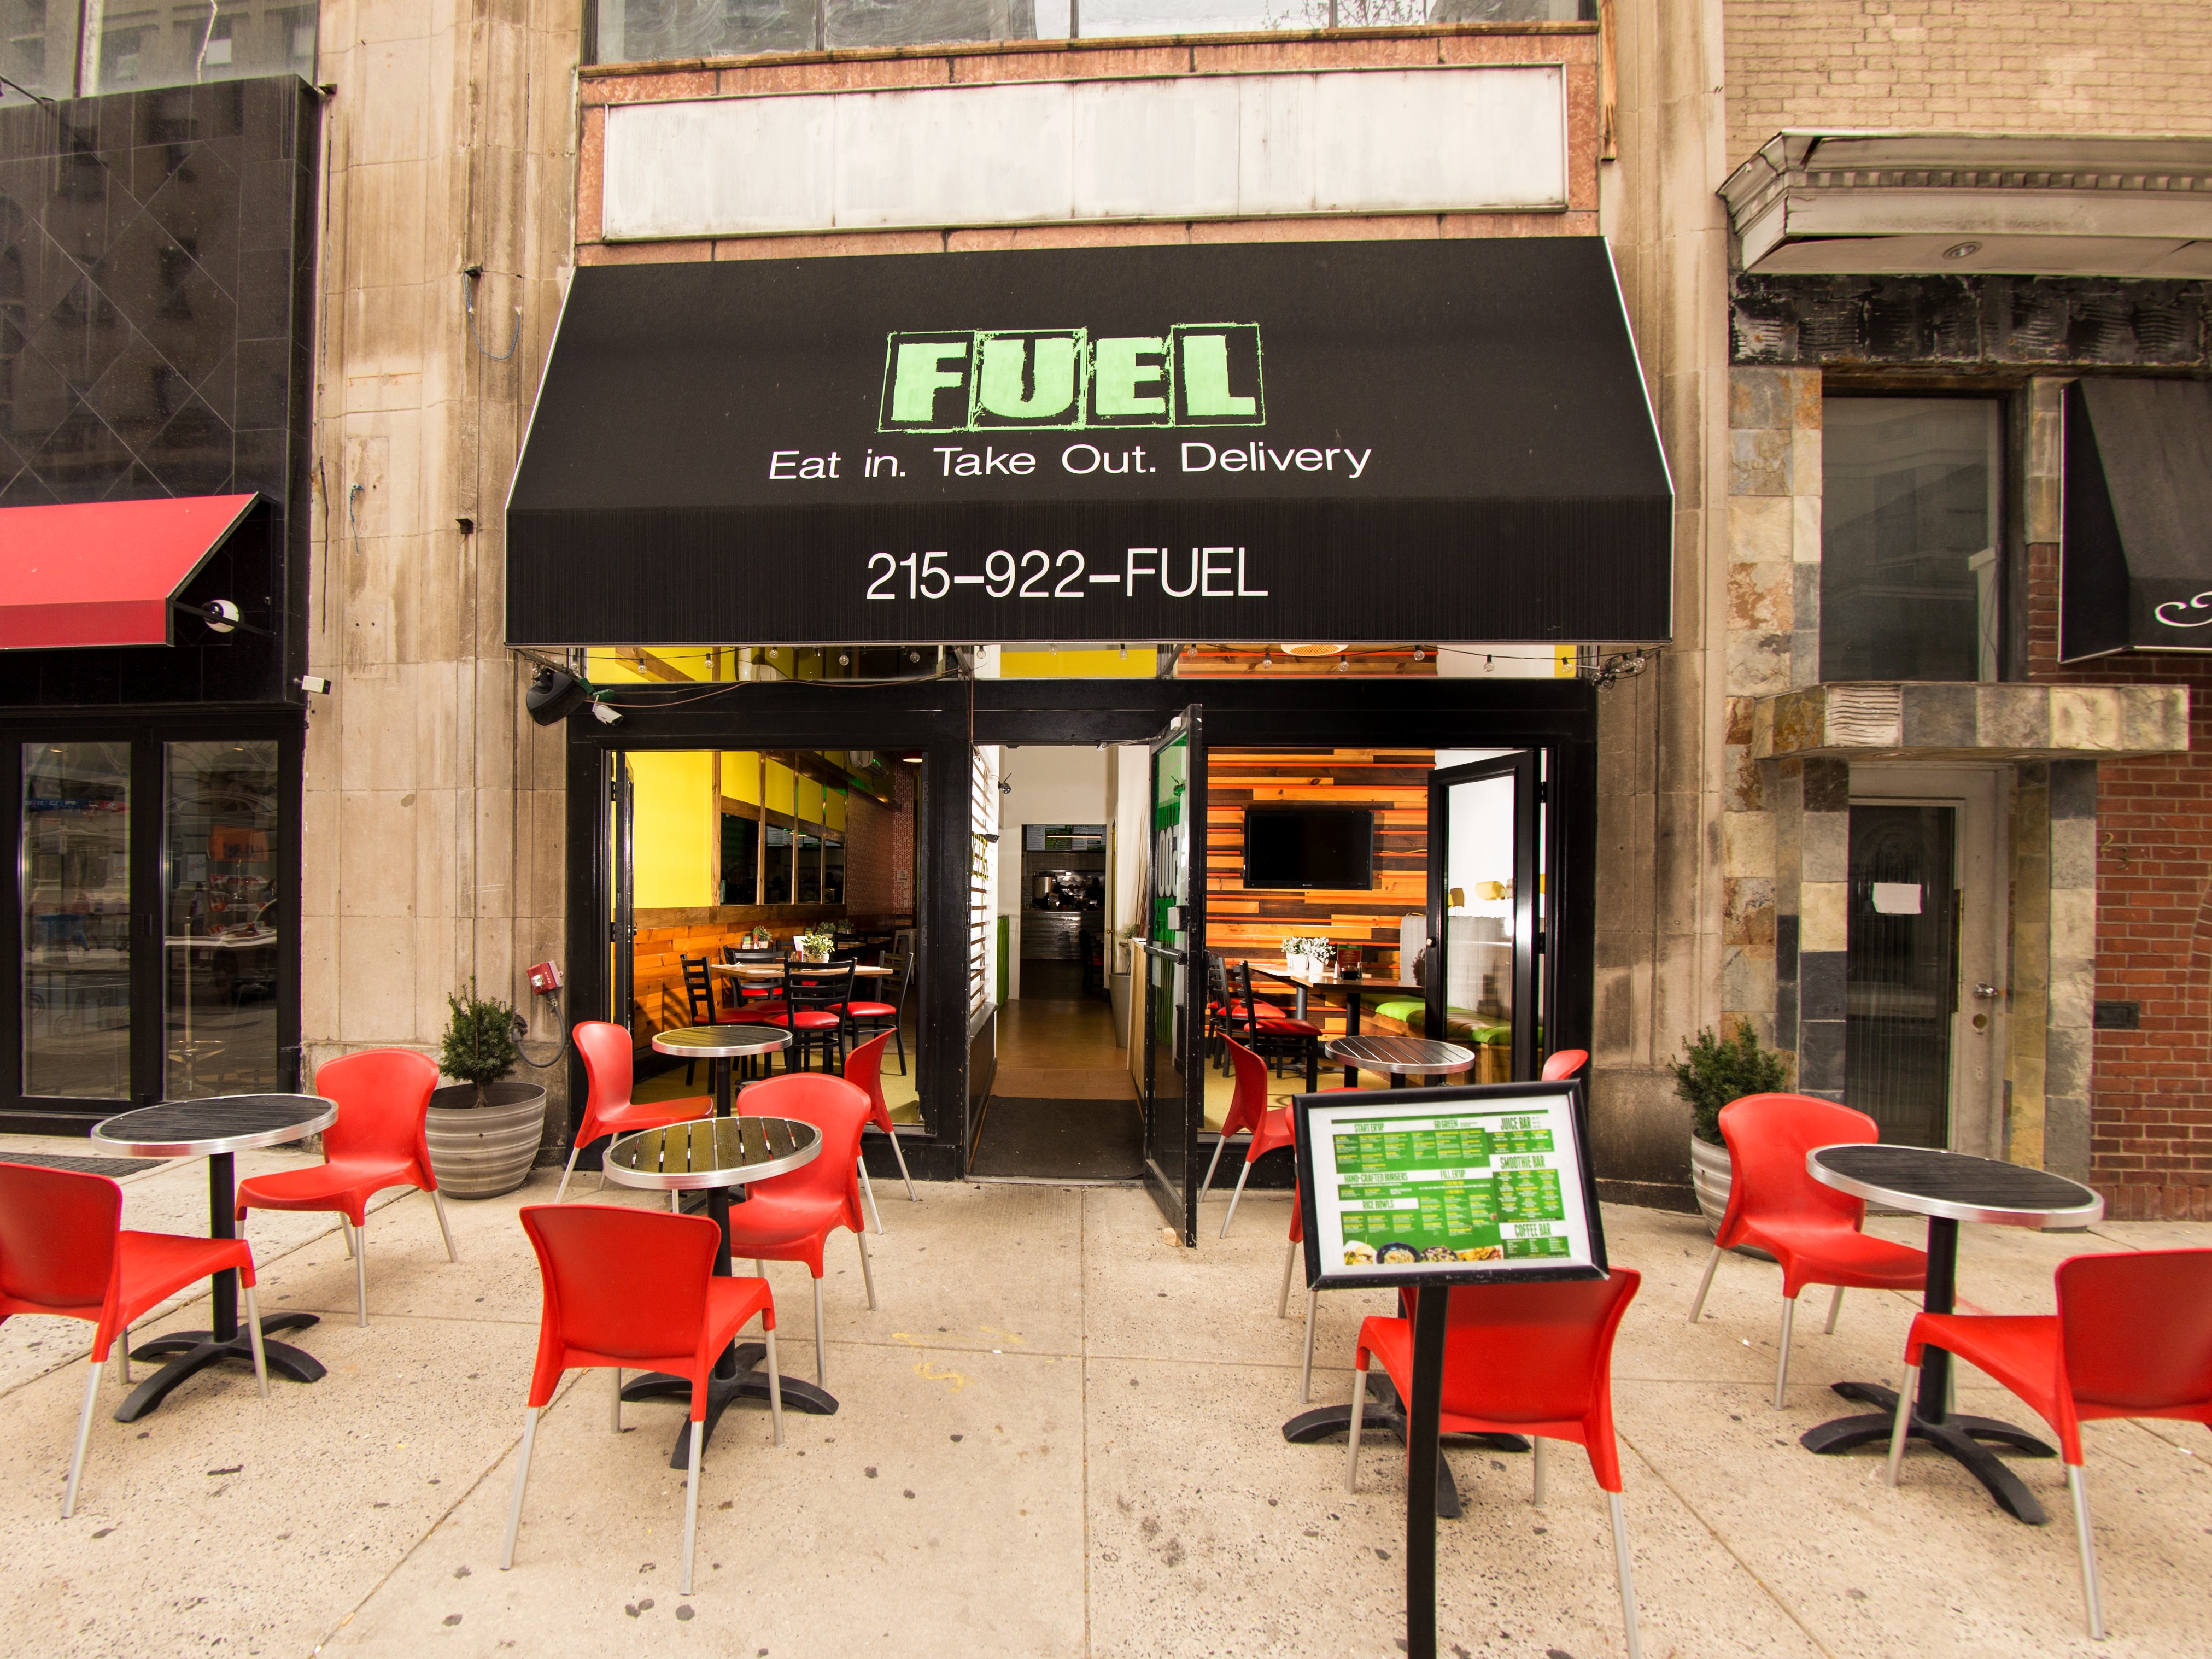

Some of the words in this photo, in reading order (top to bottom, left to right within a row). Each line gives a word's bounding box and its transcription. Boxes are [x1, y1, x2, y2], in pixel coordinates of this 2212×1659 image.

[891, 335, 1257, 421] FUEL
[769, 451, 840, 479] Eat
[864, 449, 906, 477] in.
[933, 447, 1036, 476] Take
[1062, 444, 1157, 474] Out.
[1181, 442, 1372, 478] Delivery
[867, 548, 1268, 599] 215-922-FUEL
[1435, 1121, 1441, 1129] GO
[1442, 1119, 1459, 1128] GREEN
[1500, 1117, 1518, 1130] JUICE
[1519, 1117, 1531, 1129] BAR
[1500, 1156, 1531, 1169] SMOOTHIE
[1532, 1155, 1545, 1168] BAR
[1385, 1173, 1408, 1181] BURGERS
[1363, 1201, 1374, 1209] RICE
[1375, 1200, 1394, 1209] BOWLS
[1514, 1224, 1538, 1238] COFFEE
[1538, 1223, 1552, 1236] BAR
